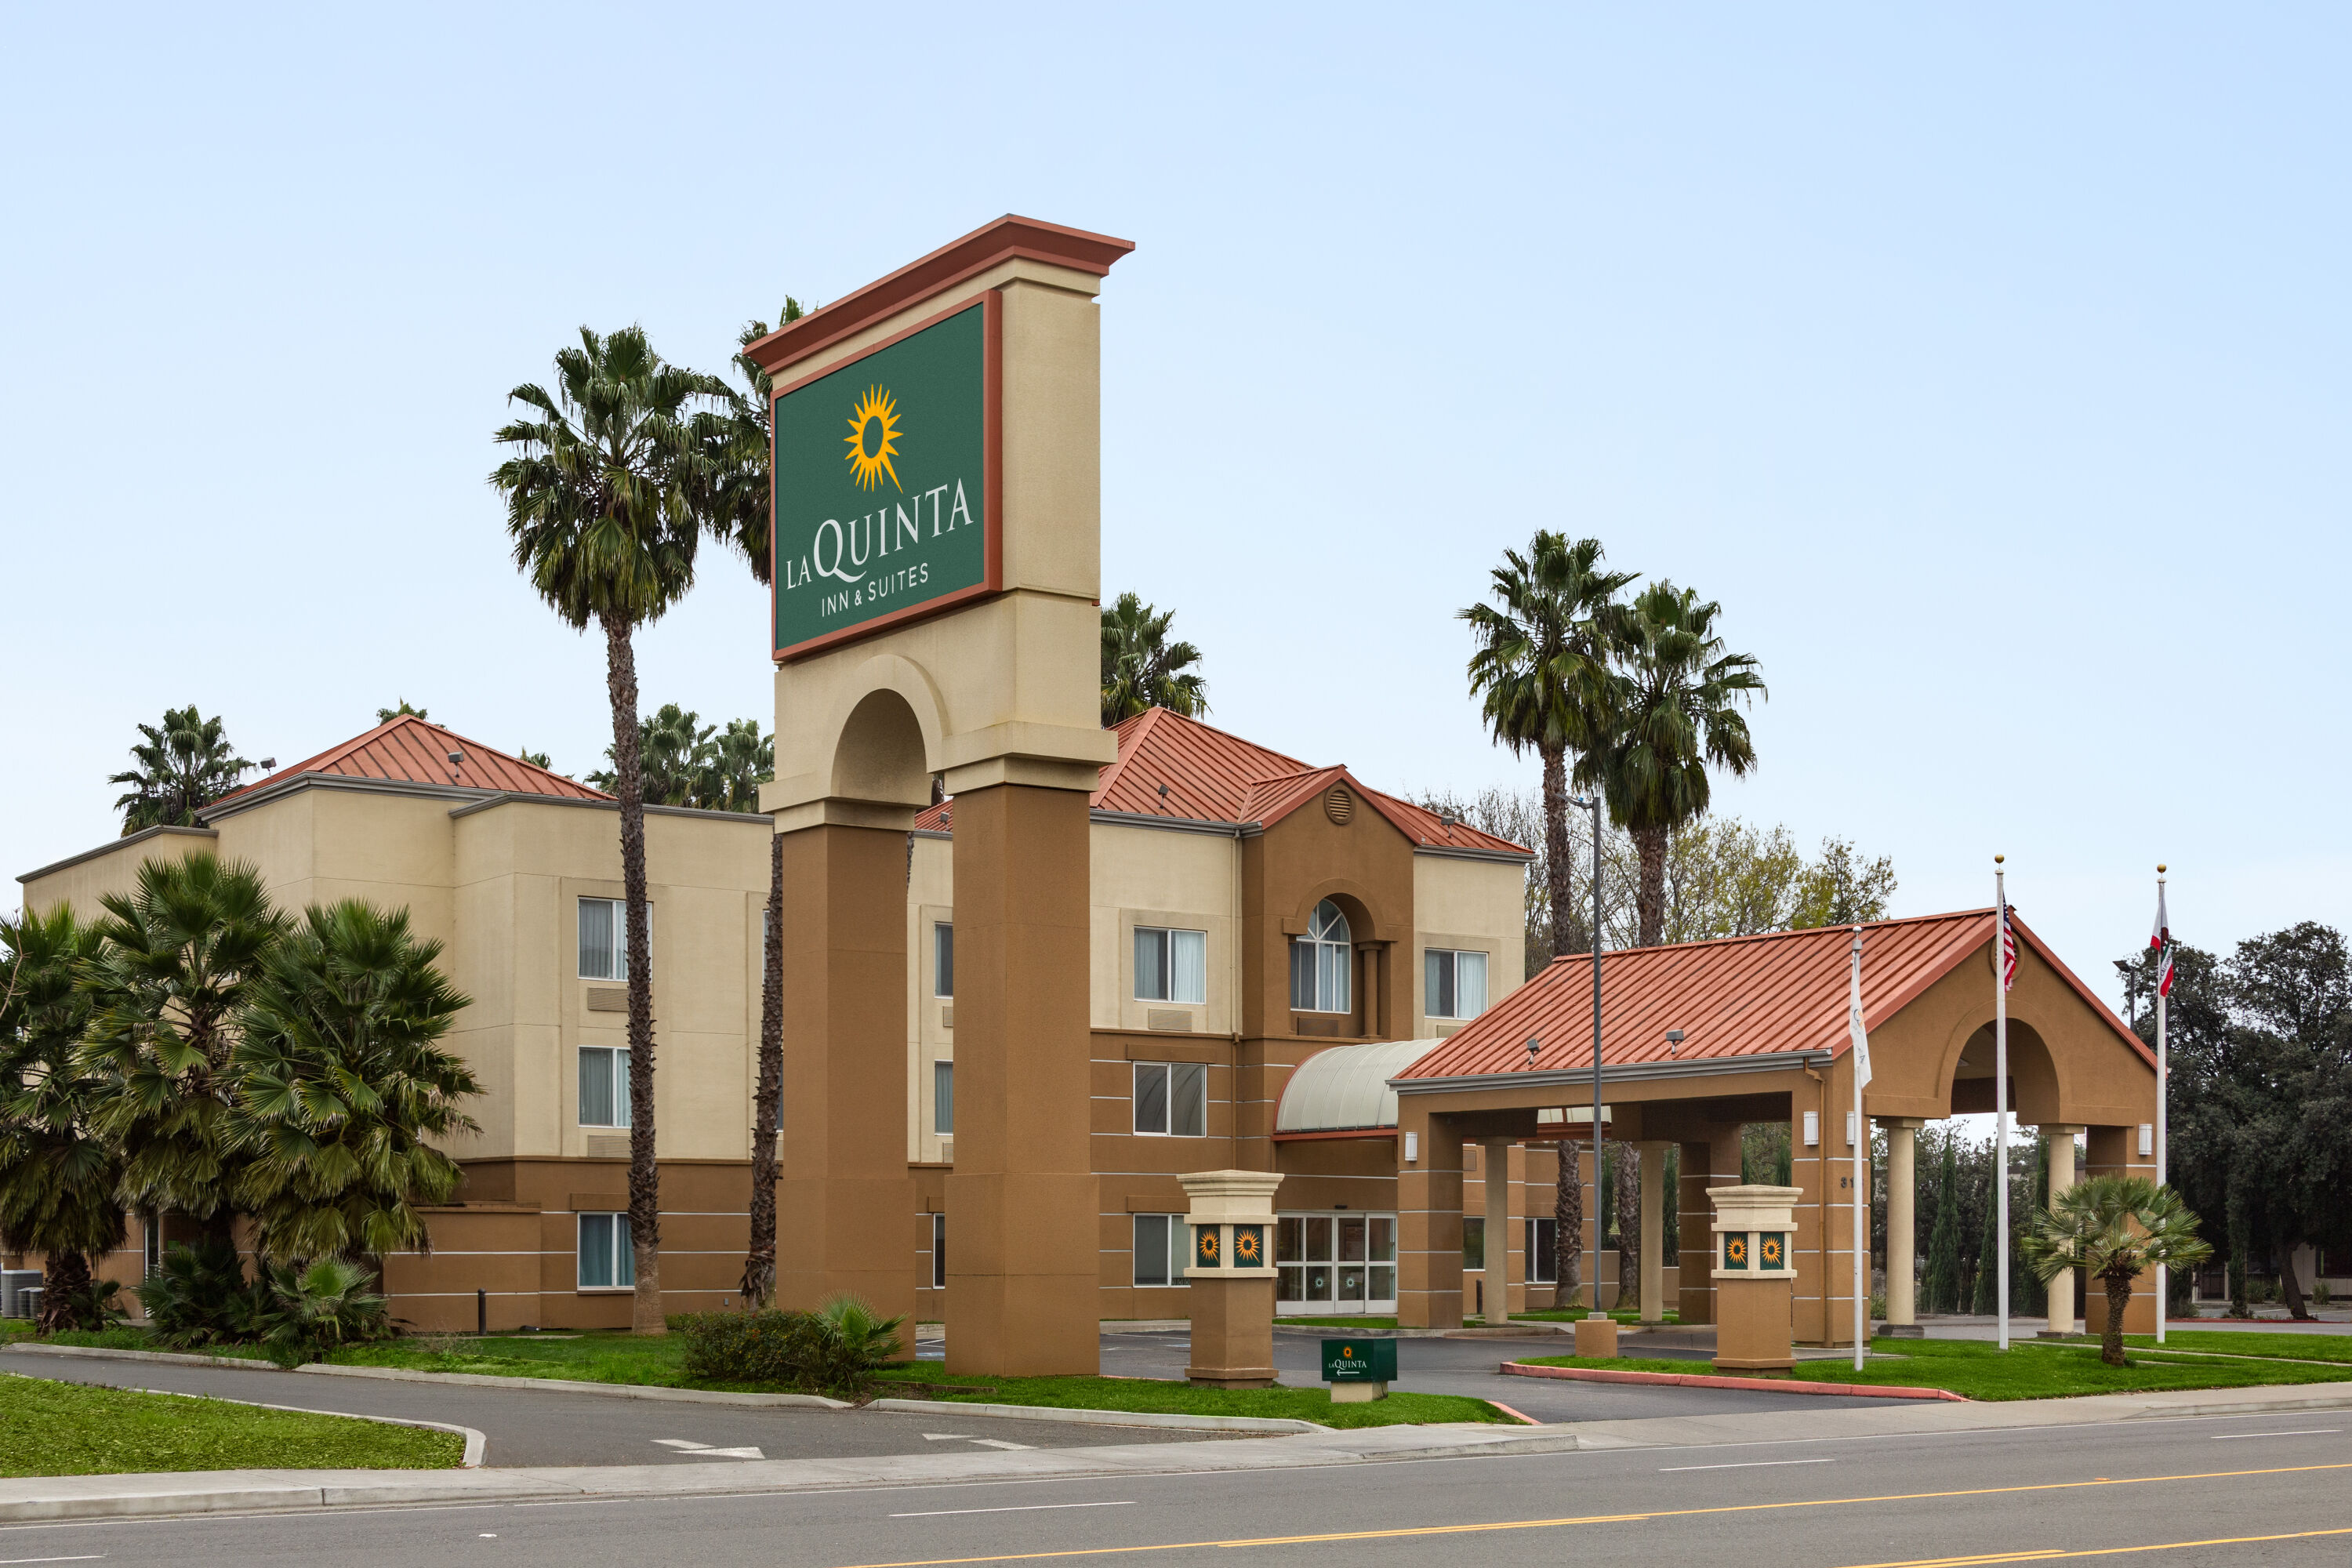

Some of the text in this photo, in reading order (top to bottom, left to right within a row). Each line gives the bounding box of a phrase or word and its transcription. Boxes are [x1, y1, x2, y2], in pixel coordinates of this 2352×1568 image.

[786, 477, 975, 590] LA QUINTA
[822, 562, 928, 617] INN & SUITES
[1334, 1359, 1367, 1370] QUINTA
